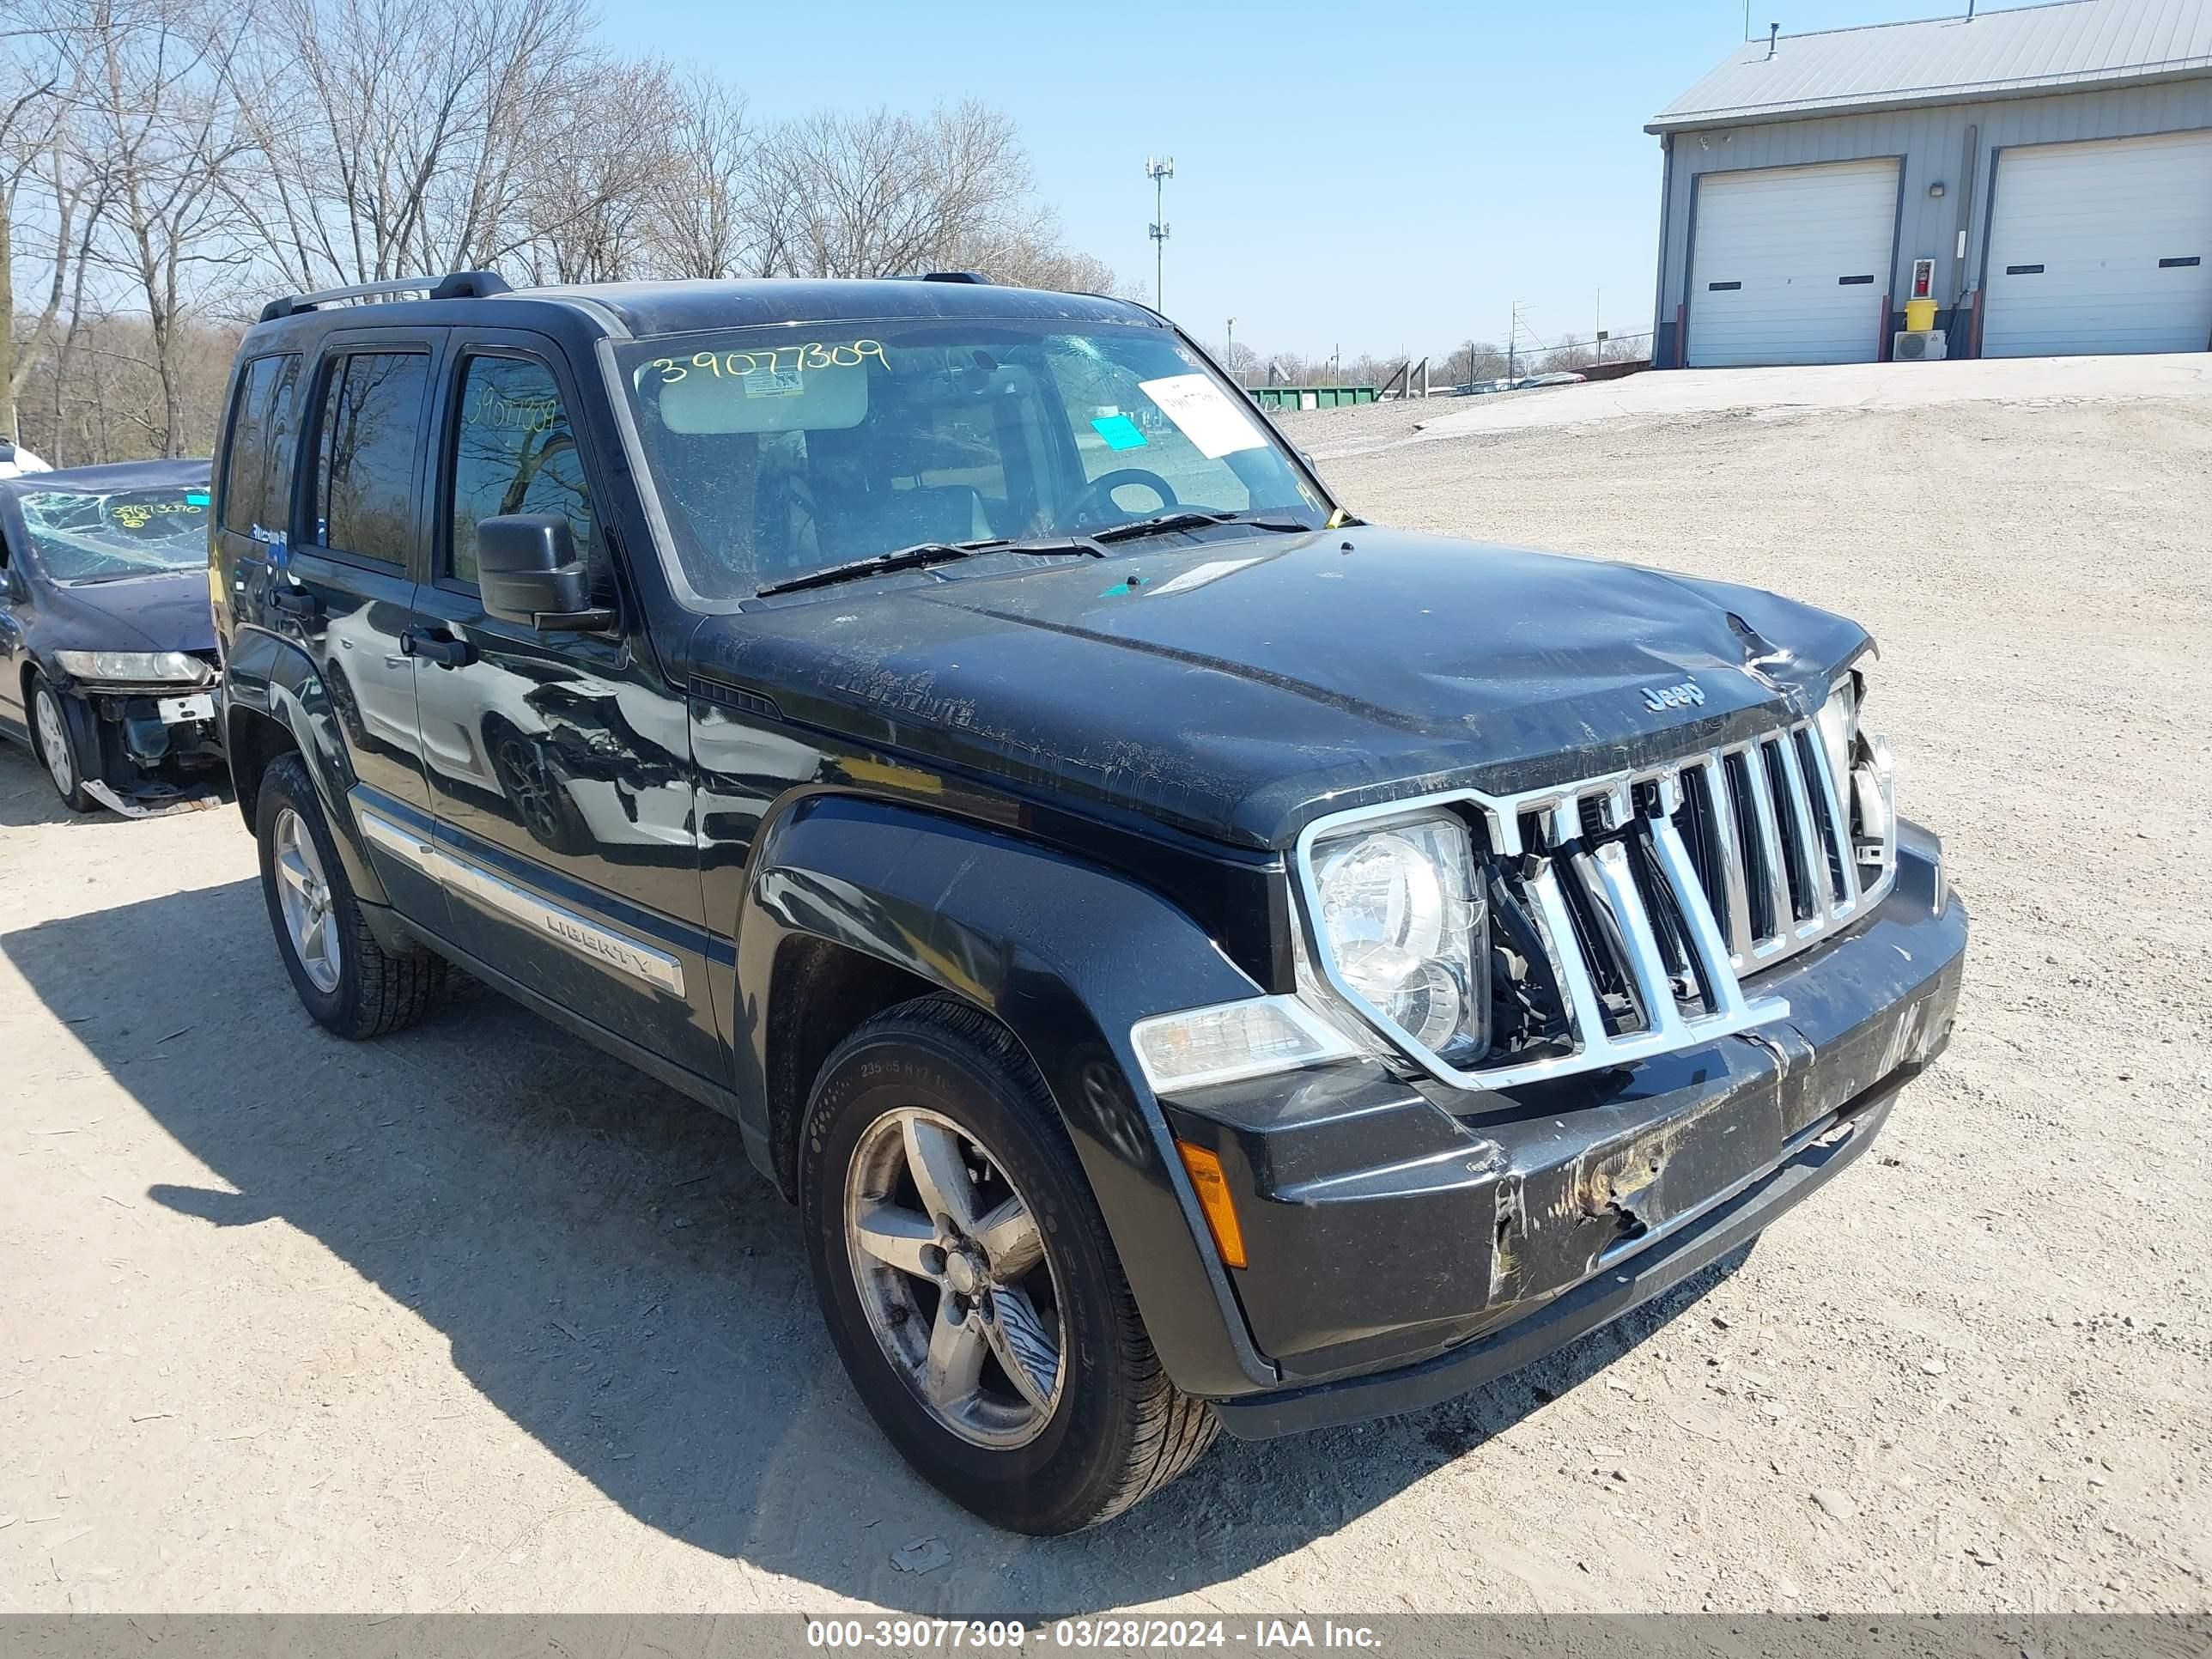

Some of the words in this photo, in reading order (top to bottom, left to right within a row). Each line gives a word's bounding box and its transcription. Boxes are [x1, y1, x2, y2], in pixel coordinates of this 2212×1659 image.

[653, 339, 891, 383] 39077309
[467, 387, 556, 433] 39077309
[1639, 682, 1705, 712] Jeep
[545, 915, 648, 973] LIBERTY
